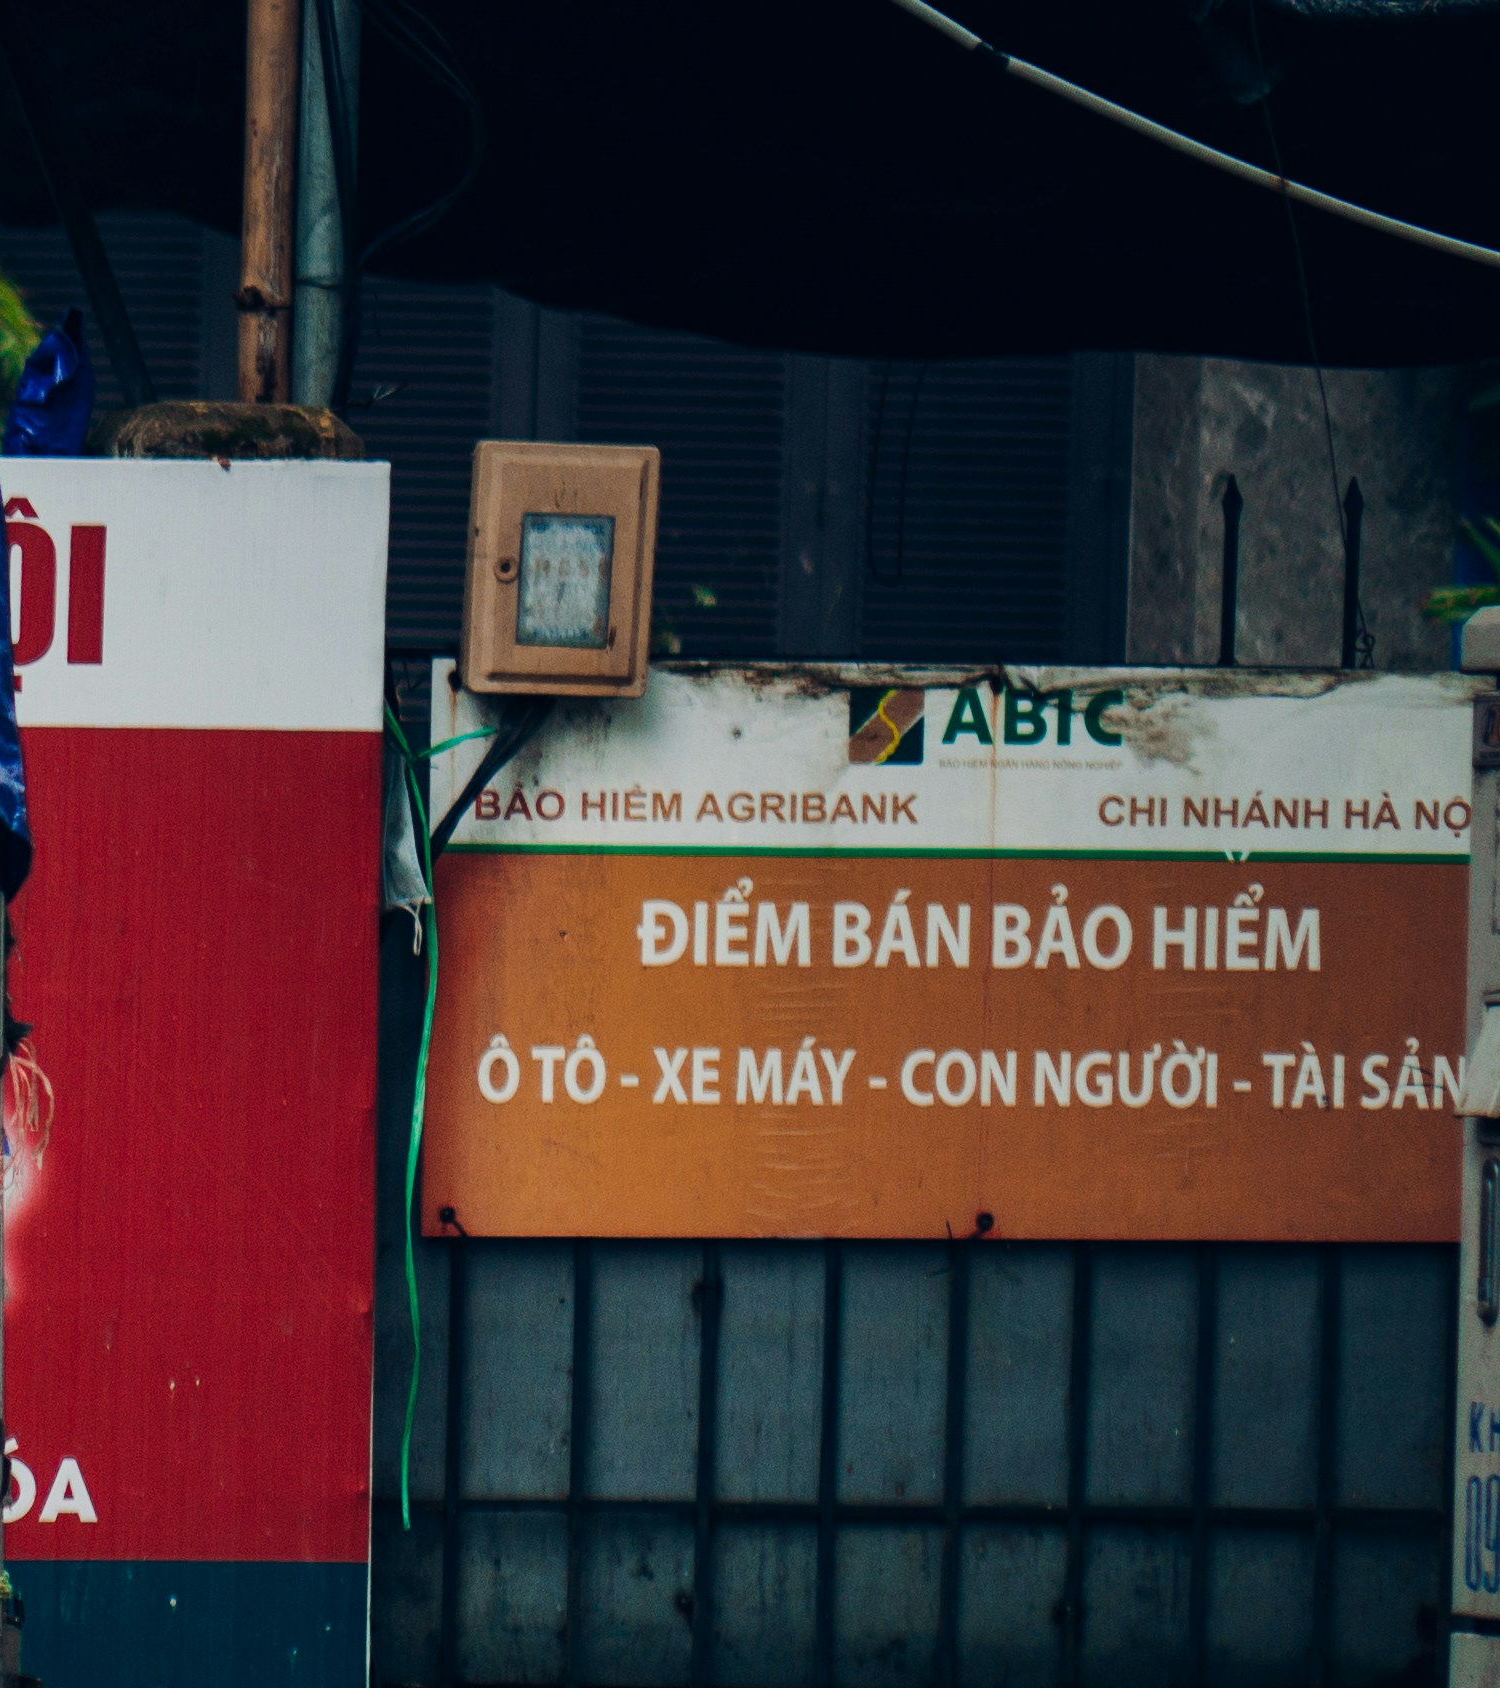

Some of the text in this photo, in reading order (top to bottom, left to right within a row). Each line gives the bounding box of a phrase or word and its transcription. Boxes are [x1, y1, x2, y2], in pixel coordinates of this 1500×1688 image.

[941, 687, 1125, 746] ABIC
[696, 791, 920, 826] AGRIBANK
[1099, 795, 1169, 828] CHI
[1182, 788, 1330, 830] NHÁNH
[1344, 791, 1402, 831] HÀ
[637, 876, 1322, 972] ĐIỂM BÁN BẢO HIỂM
[477, 1033, 520, 1105] Ô
[531, 1033, 607, 1105] TÔ
[652, 1046, 721, 1106] XE
[735, 1035, 856, 1106] MÁY
[901, 1048, 1018, 1108] CON
[1033, 1039, 1219, 1110] NGƯỜI
[1261, 1040, 1345, 1110] TÀI
[1360, 1036, 1466, 1111] SẢN
